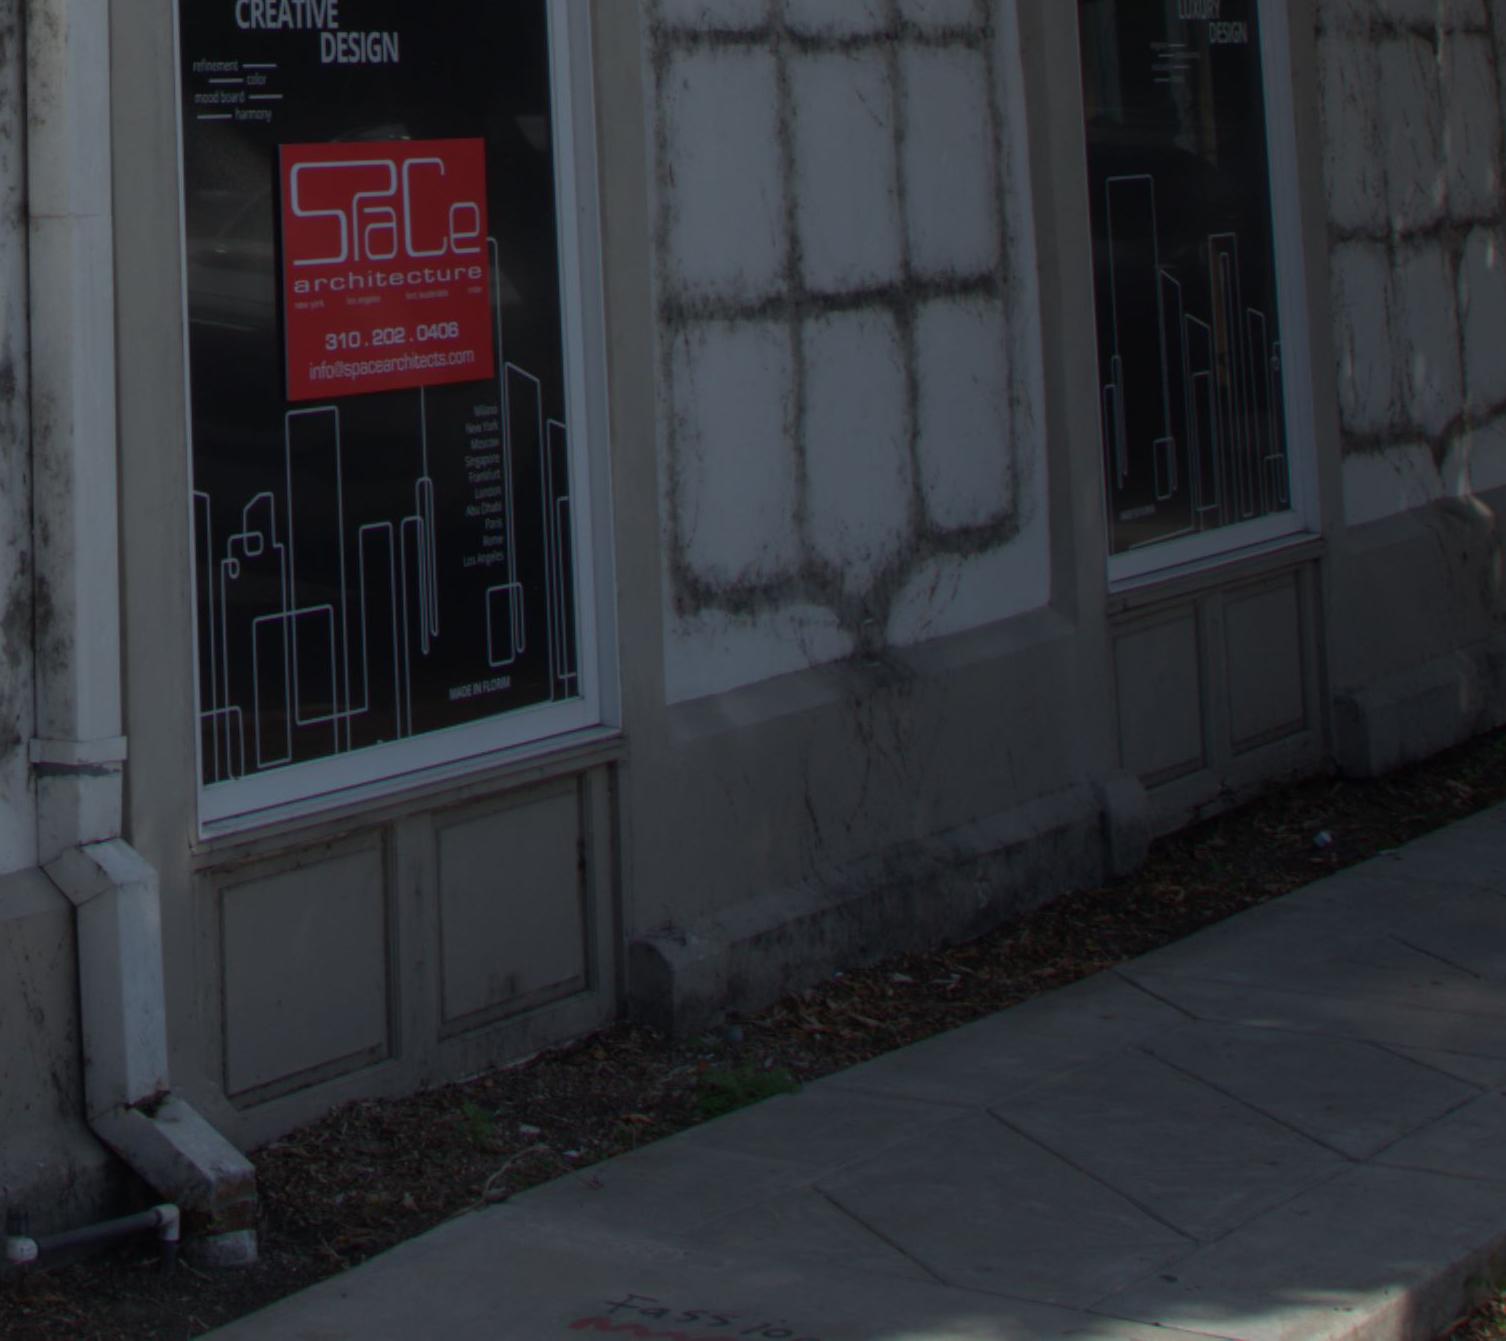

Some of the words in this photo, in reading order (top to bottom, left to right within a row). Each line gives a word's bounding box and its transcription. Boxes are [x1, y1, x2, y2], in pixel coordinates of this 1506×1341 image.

[1209, 21, 1247, 44] DESIGN
[320, 31, 400, 64] DESIGN
[192, 58, 239, 73] refinement
[246, 73, 267, 86] color
[194, 91, 219, 104] mood
[220, 90, 245, 103] board
[235, 108, 272, 123] harmony
[293, 265, 482, 294] architecture
[309, 349, 475, 380] info@spacearchitects.com
[449, 684, 472, 702] MADE
[473, 681, 482, 695] IN
[483, 675, 511, 694] FLORIM
